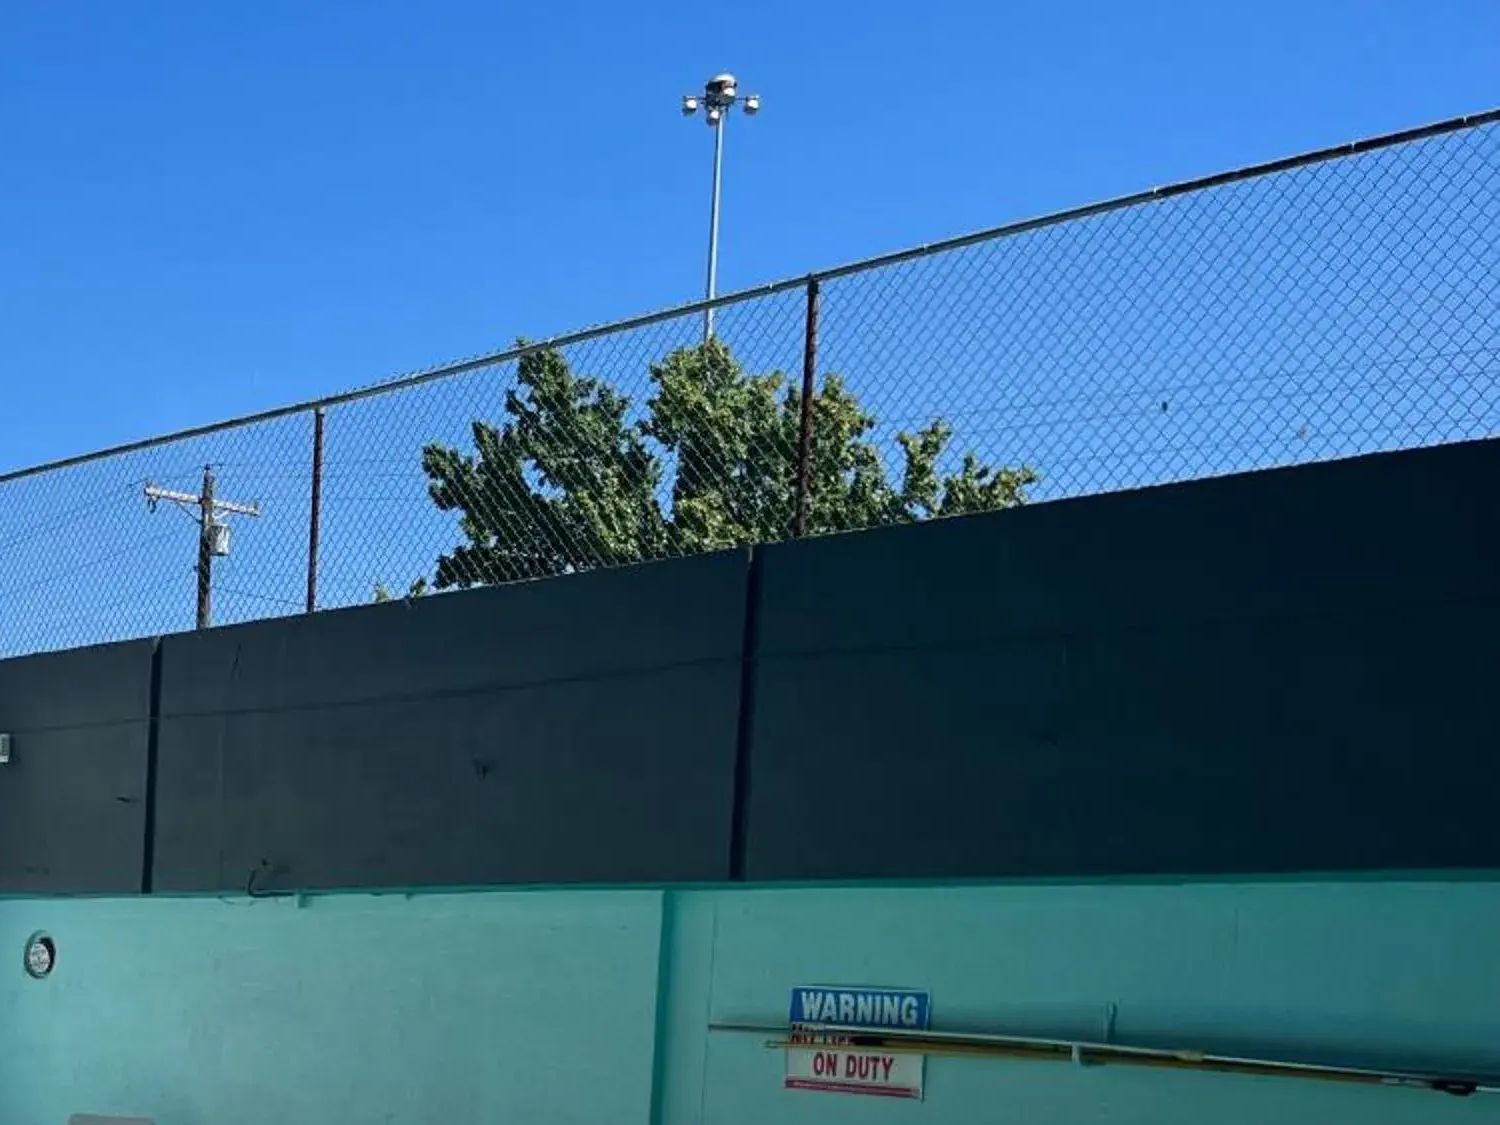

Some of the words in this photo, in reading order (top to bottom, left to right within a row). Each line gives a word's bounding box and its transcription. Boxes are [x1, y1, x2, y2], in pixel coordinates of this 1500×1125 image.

[800, 991, 919, 1026] WARNING
[813, 1051, 838, 1076] ON
[845, 1054, 895, 1081] DUTY
